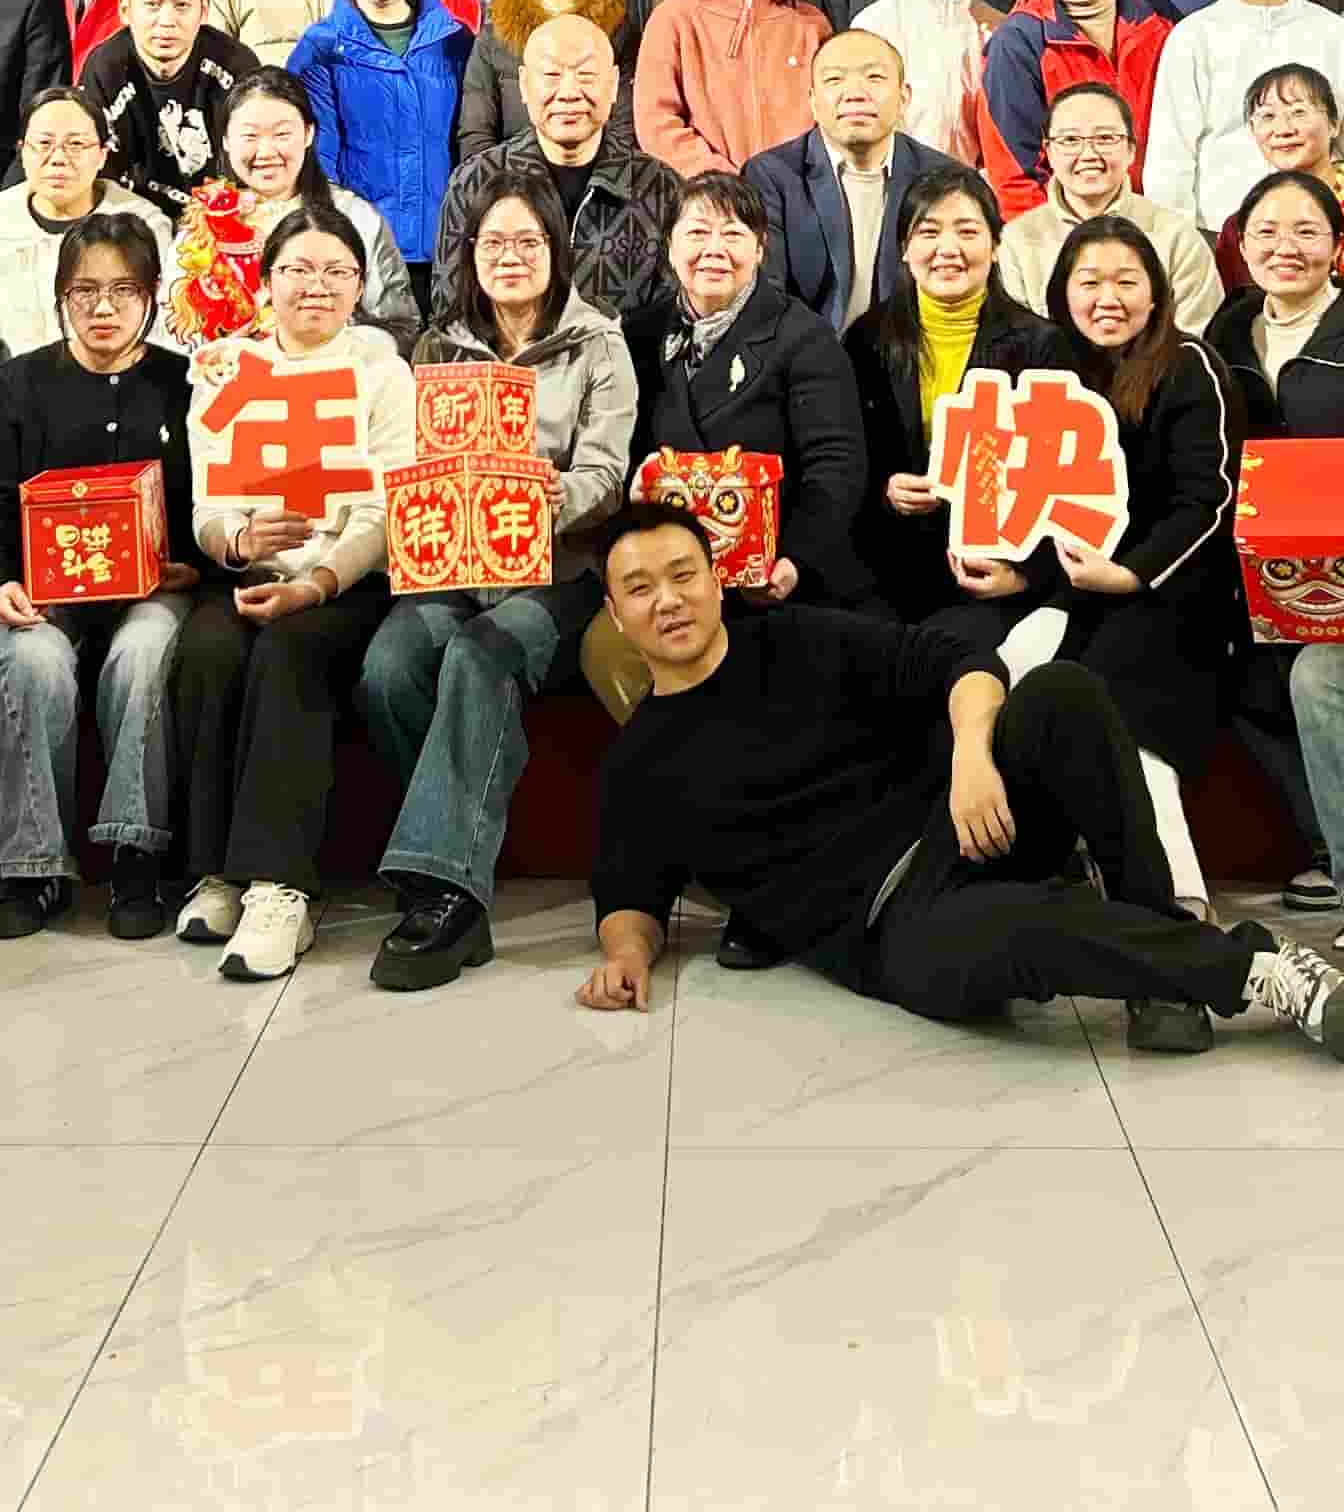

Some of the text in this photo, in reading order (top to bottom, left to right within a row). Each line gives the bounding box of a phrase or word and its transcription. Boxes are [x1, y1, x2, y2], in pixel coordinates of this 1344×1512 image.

[200, 350, 375, 519] 年
[431, 390, 473, 430] 新
[501, 393, 528, 434] 年
[938, 380, 1116, 549] 快
[404, 502, 452, 558] 祥
[488, 497, 534, 553] 年
